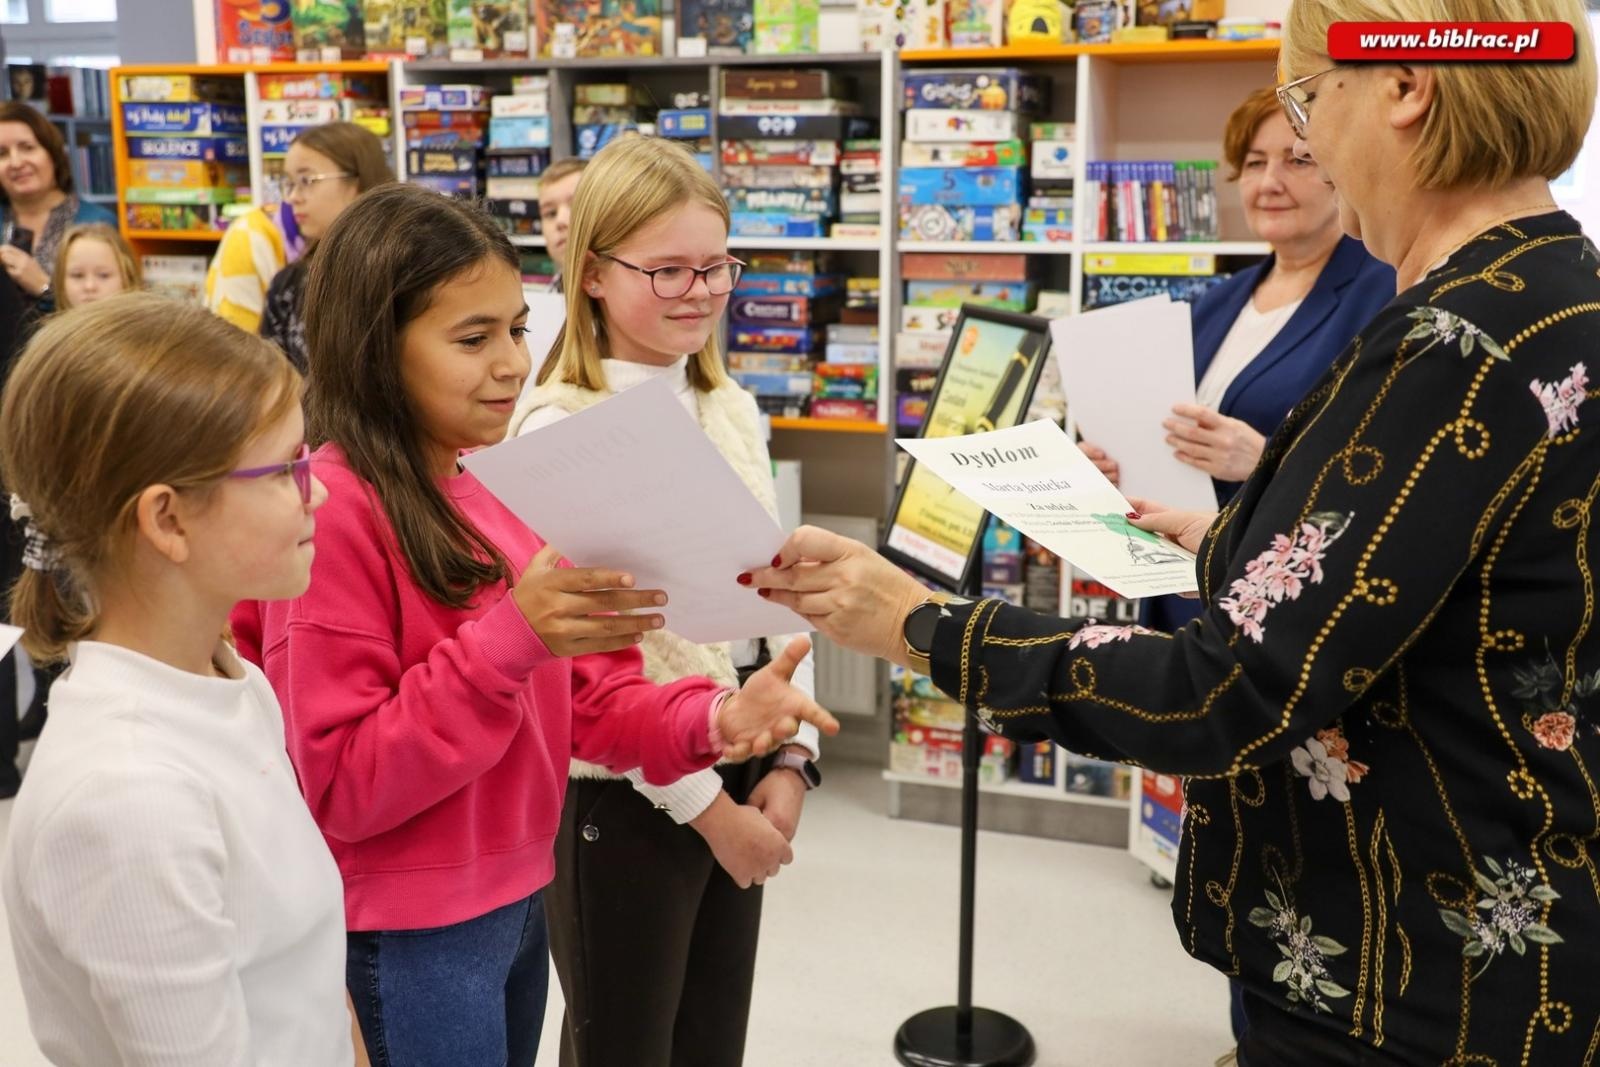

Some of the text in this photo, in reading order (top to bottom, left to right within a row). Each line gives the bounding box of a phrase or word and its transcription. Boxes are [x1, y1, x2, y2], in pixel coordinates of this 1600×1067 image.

[141, 138, 199, 155] SEQUENCE
[950, 445, 1040, 469] Dyplom
[981, 478, 1072, 494] Marta Janicka
